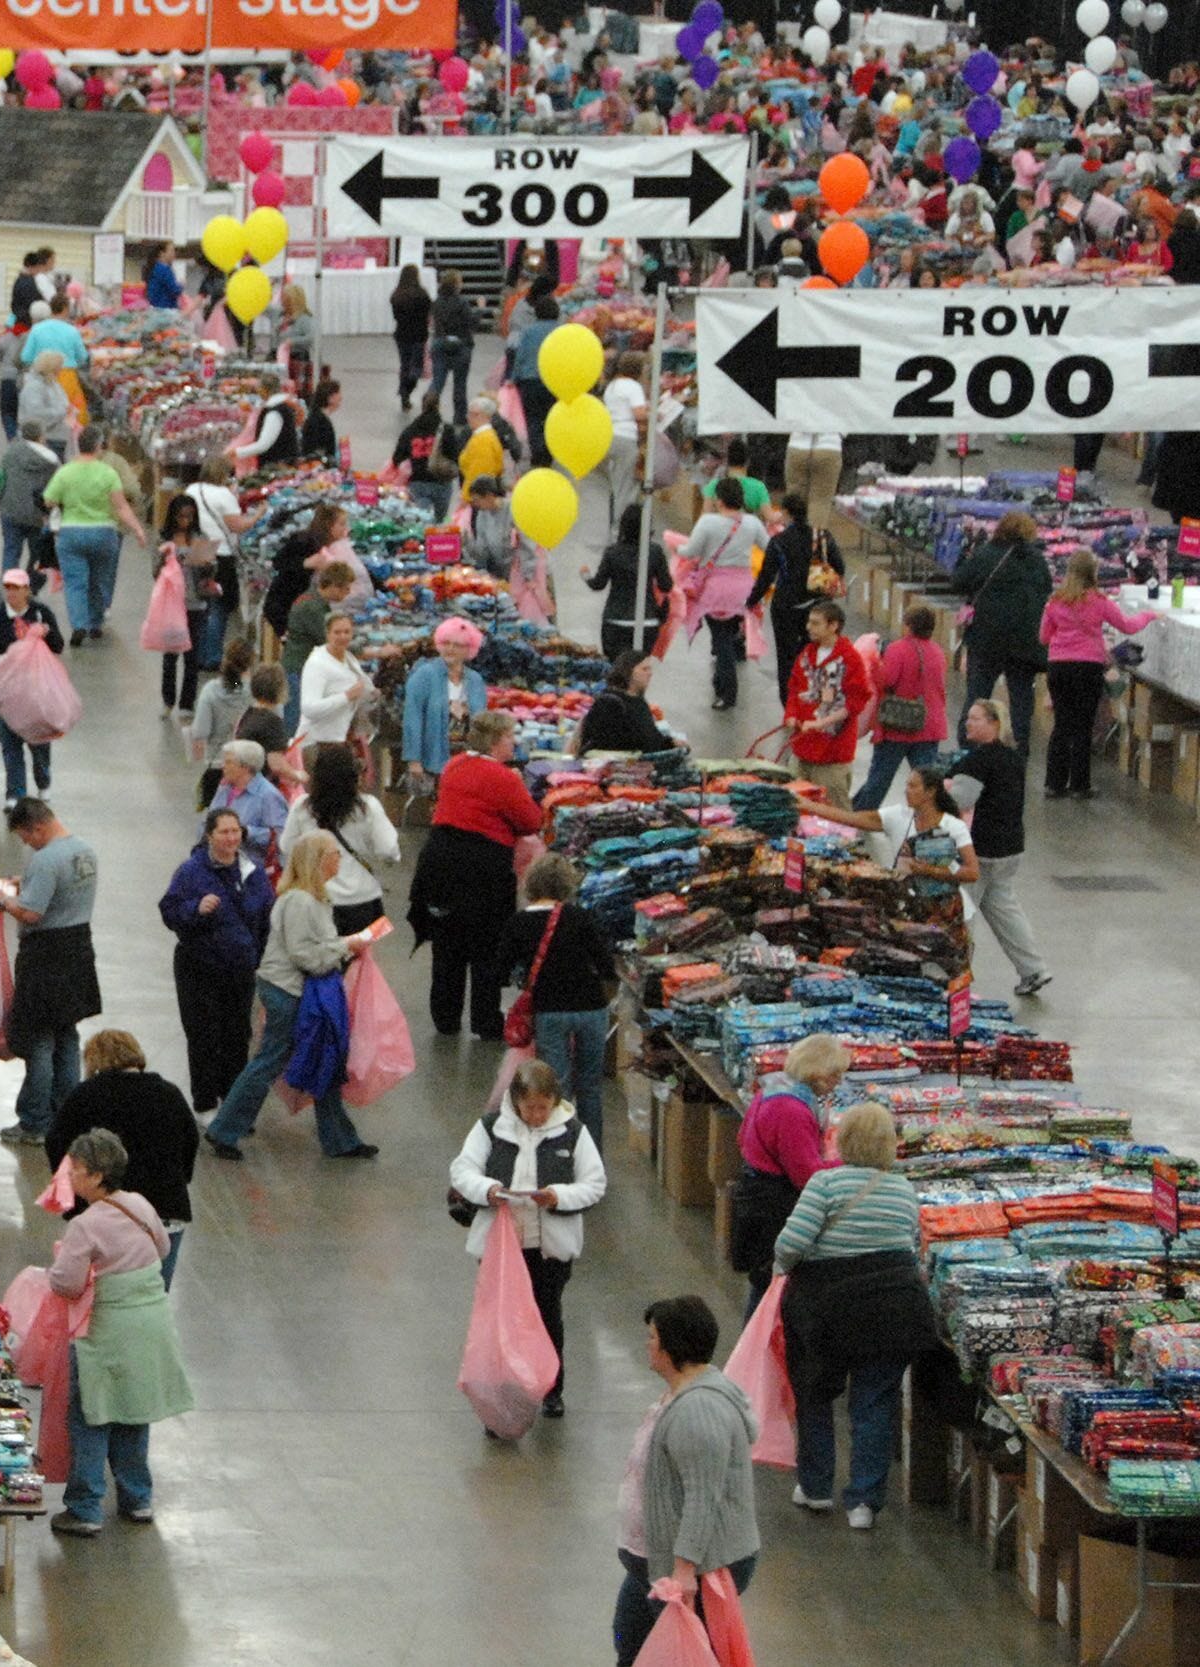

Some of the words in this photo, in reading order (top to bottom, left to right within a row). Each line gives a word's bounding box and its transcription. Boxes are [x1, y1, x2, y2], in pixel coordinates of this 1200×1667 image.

[494, 149, 579, 170] ROW
[462, 183, 609, 227] 300
[942, 305, 1070, 337] ROW
[892, 354, 1114, 419] 200
